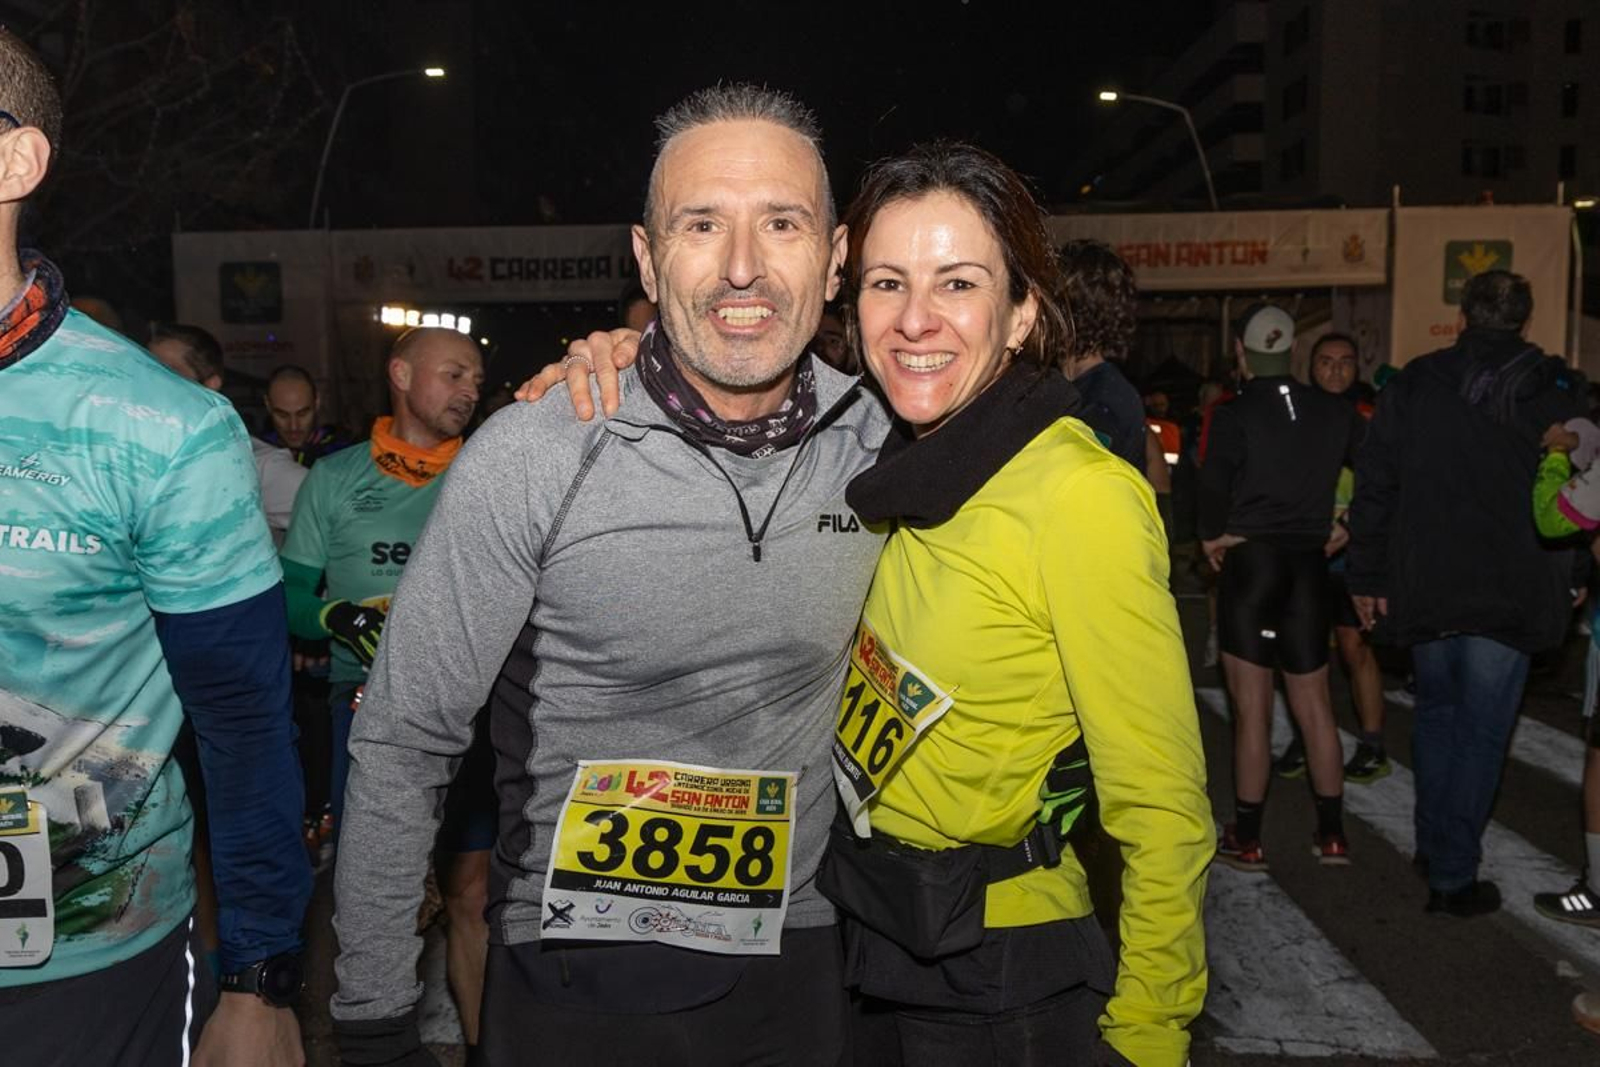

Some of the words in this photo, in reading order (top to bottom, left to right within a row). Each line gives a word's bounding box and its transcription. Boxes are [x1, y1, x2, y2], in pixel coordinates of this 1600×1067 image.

[1118, 242, 1172, 268] SAN
[1176, 240, 1269, 267] ANTON
[447, 256, 484, 281] 42
[490, 256, 613, 281] CARRERA
[817, 514, 860, 533] FILA
[0, 524, 102, 555] TRAILS
[838, 665, 904, 777] 116
[625, 770, 672, 803] 42
[674, 771, 719, 785] CARRERA
[670, 790, 702, 805] SAN
[703, 793, 750, 809] ANTON
[577, 810, 775, 886] 3858
[593, 879, 621, 891] JUAN
[624, 883, 669, 897] ANTONIO
[671, 888, 714, 900] AGUILAR
[717, 892, 750, 904] GARCIA
